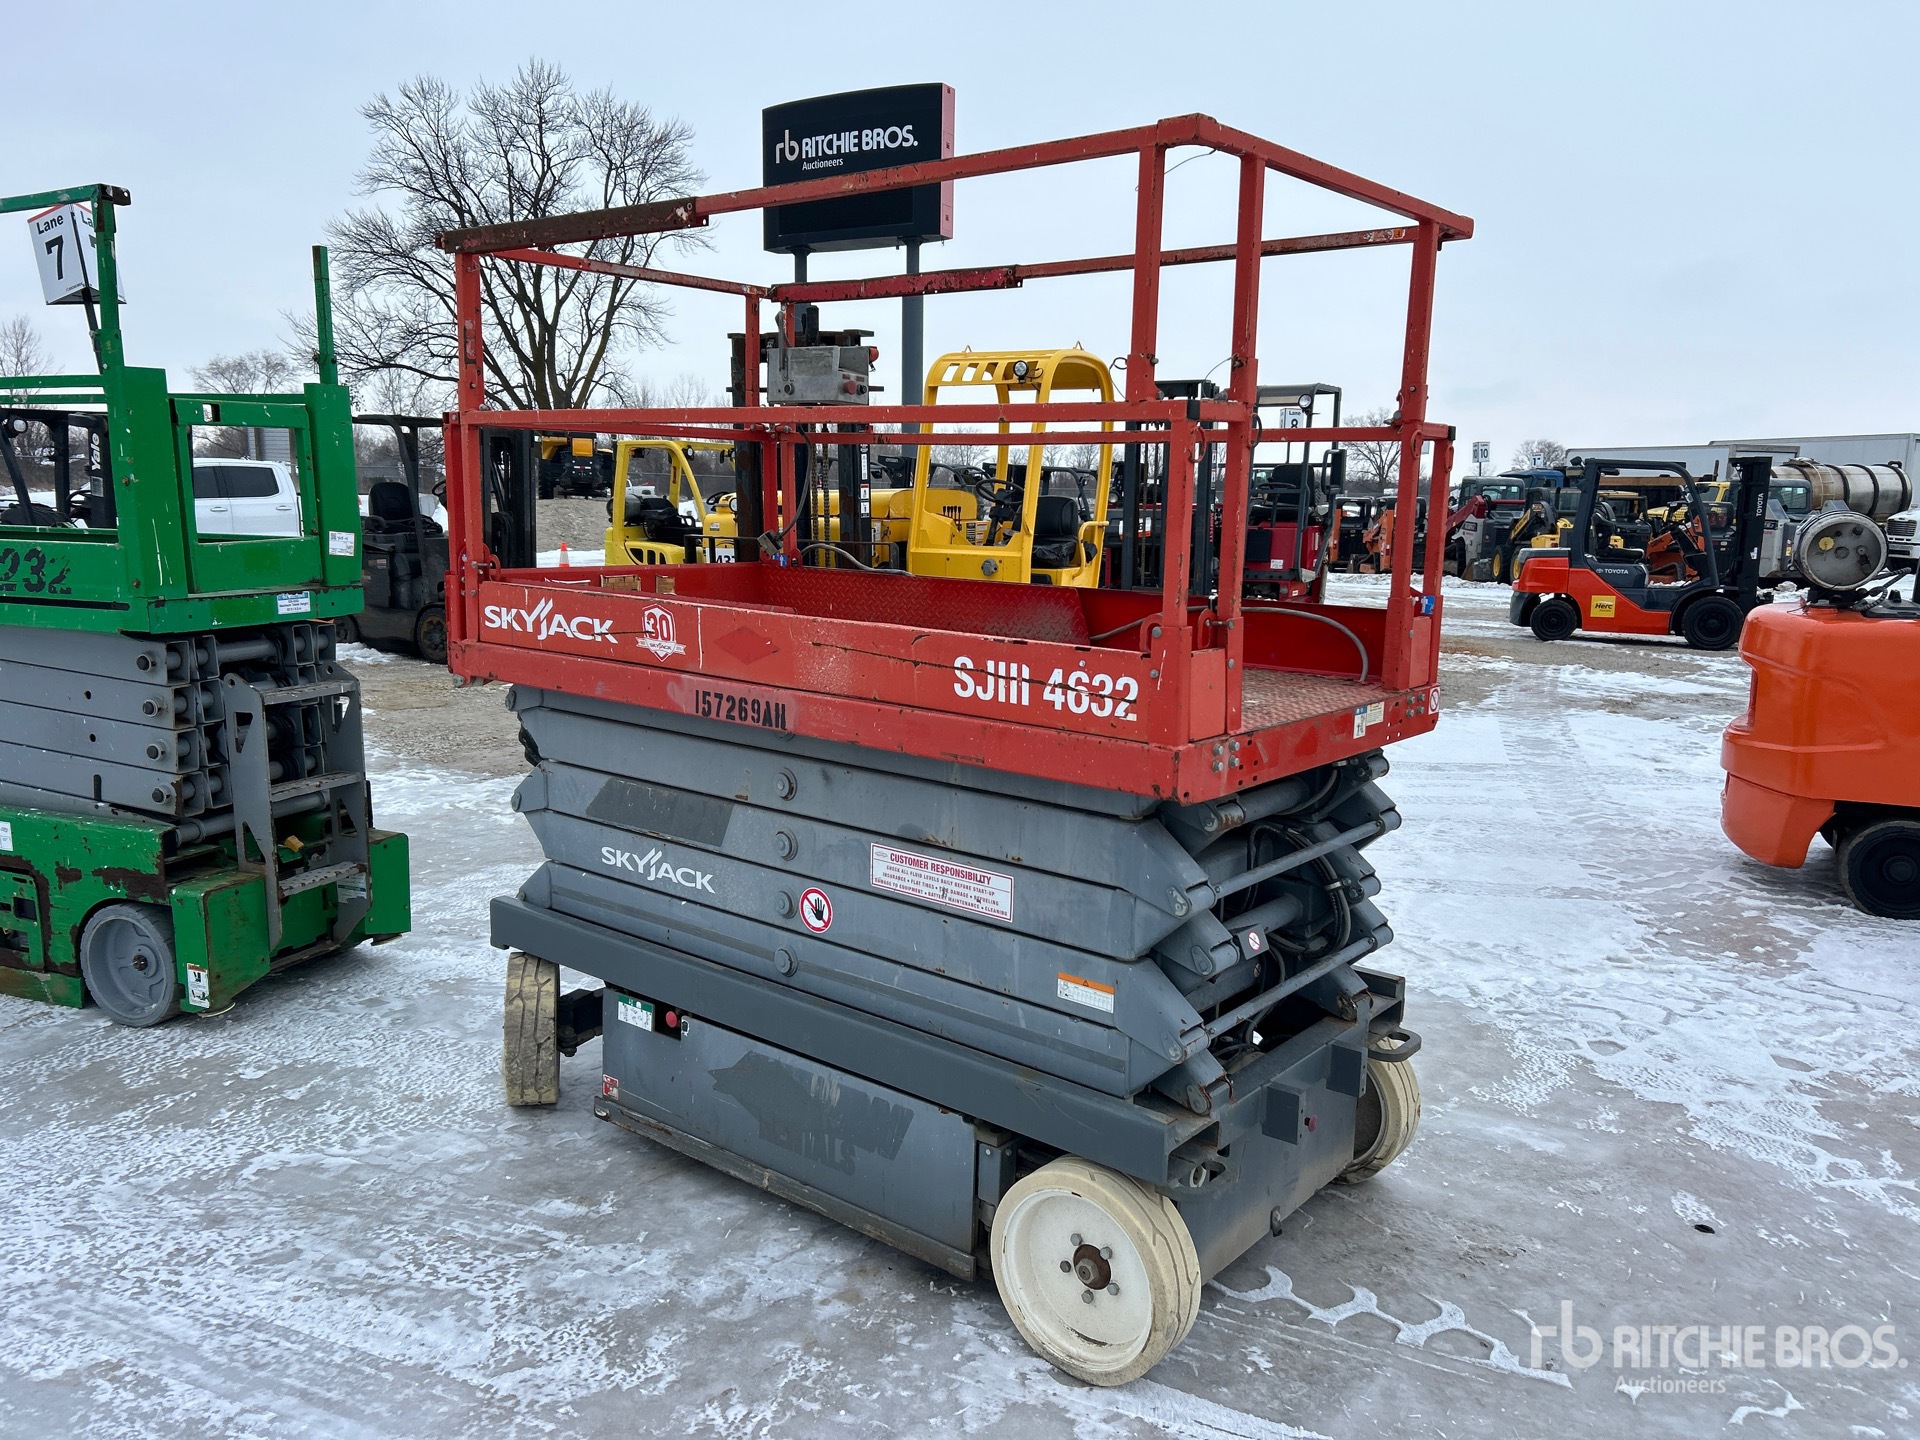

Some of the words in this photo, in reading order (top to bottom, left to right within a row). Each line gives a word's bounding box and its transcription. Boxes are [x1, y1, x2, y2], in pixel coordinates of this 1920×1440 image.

[801, 130, 859, 159] RITCHIE
[861, 124, 918, 151] BROS.
[801, 157, 844, 171] Auctioneers
[36, 214, 64, 235] Lane
[44, 234, 64, 281] 7
[91, 432, 100, 471] Yale
[1480, 448, 1489, 458] 10
[1756, 492, 1764, 517] TOYOTA
[484, 597, 618, 644] SKYJACK
[1594, 602, 1613, 610] Herc
[646, 611, 671, 642] 30
[952, 655, 1030, 706] SJIII
[1042, 666, 1139, 722] 4632
[601, 846, 716, 894] SKYJACK
[890, 852, 929, 870] CUSTOMER
[930, 862, 991, 885] RESPONSIBILITY
[874, 877, 892, 885] DAMAGE
[899, 883, 924, 895] EQUIPMENT
[948, 896, 980, 909] MAINTENANCE
[984, 906, 1008, 916] CLEANING
[882, 872, 906, 883] INSURANCE
[922, 881, 935, 890] TIRES
[950, 889, 969, 898] DAMAGE
[923, 874, 940, 883] LEVELS
[940, 878, 953, 886] DAILY
[954, 882, 972, 891] BEFORE
[972, 886, 995, 897] START-UP
